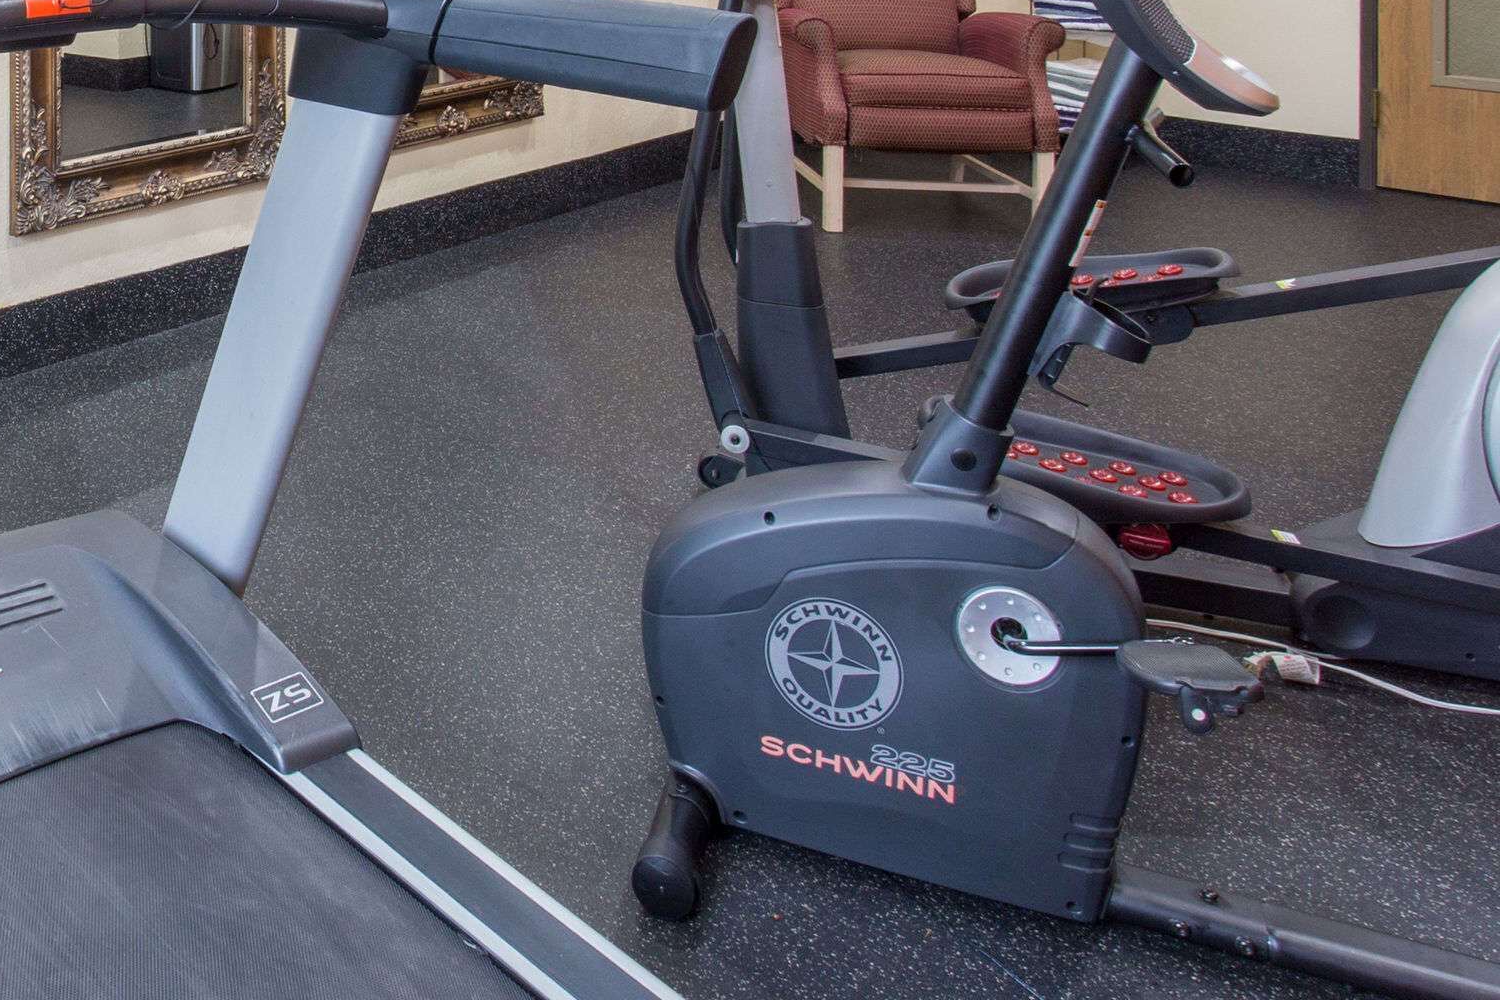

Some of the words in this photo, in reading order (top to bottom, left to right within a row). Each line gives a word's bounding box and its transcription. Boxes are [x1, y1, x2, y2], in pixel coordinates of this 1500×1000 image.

[774, 603, 893, 663] SCHWINN
[782, 676, 885, 724] QUALITY
[760, 735, 956, 805] SCHWINN
[870, 744, 955, 783] 225
